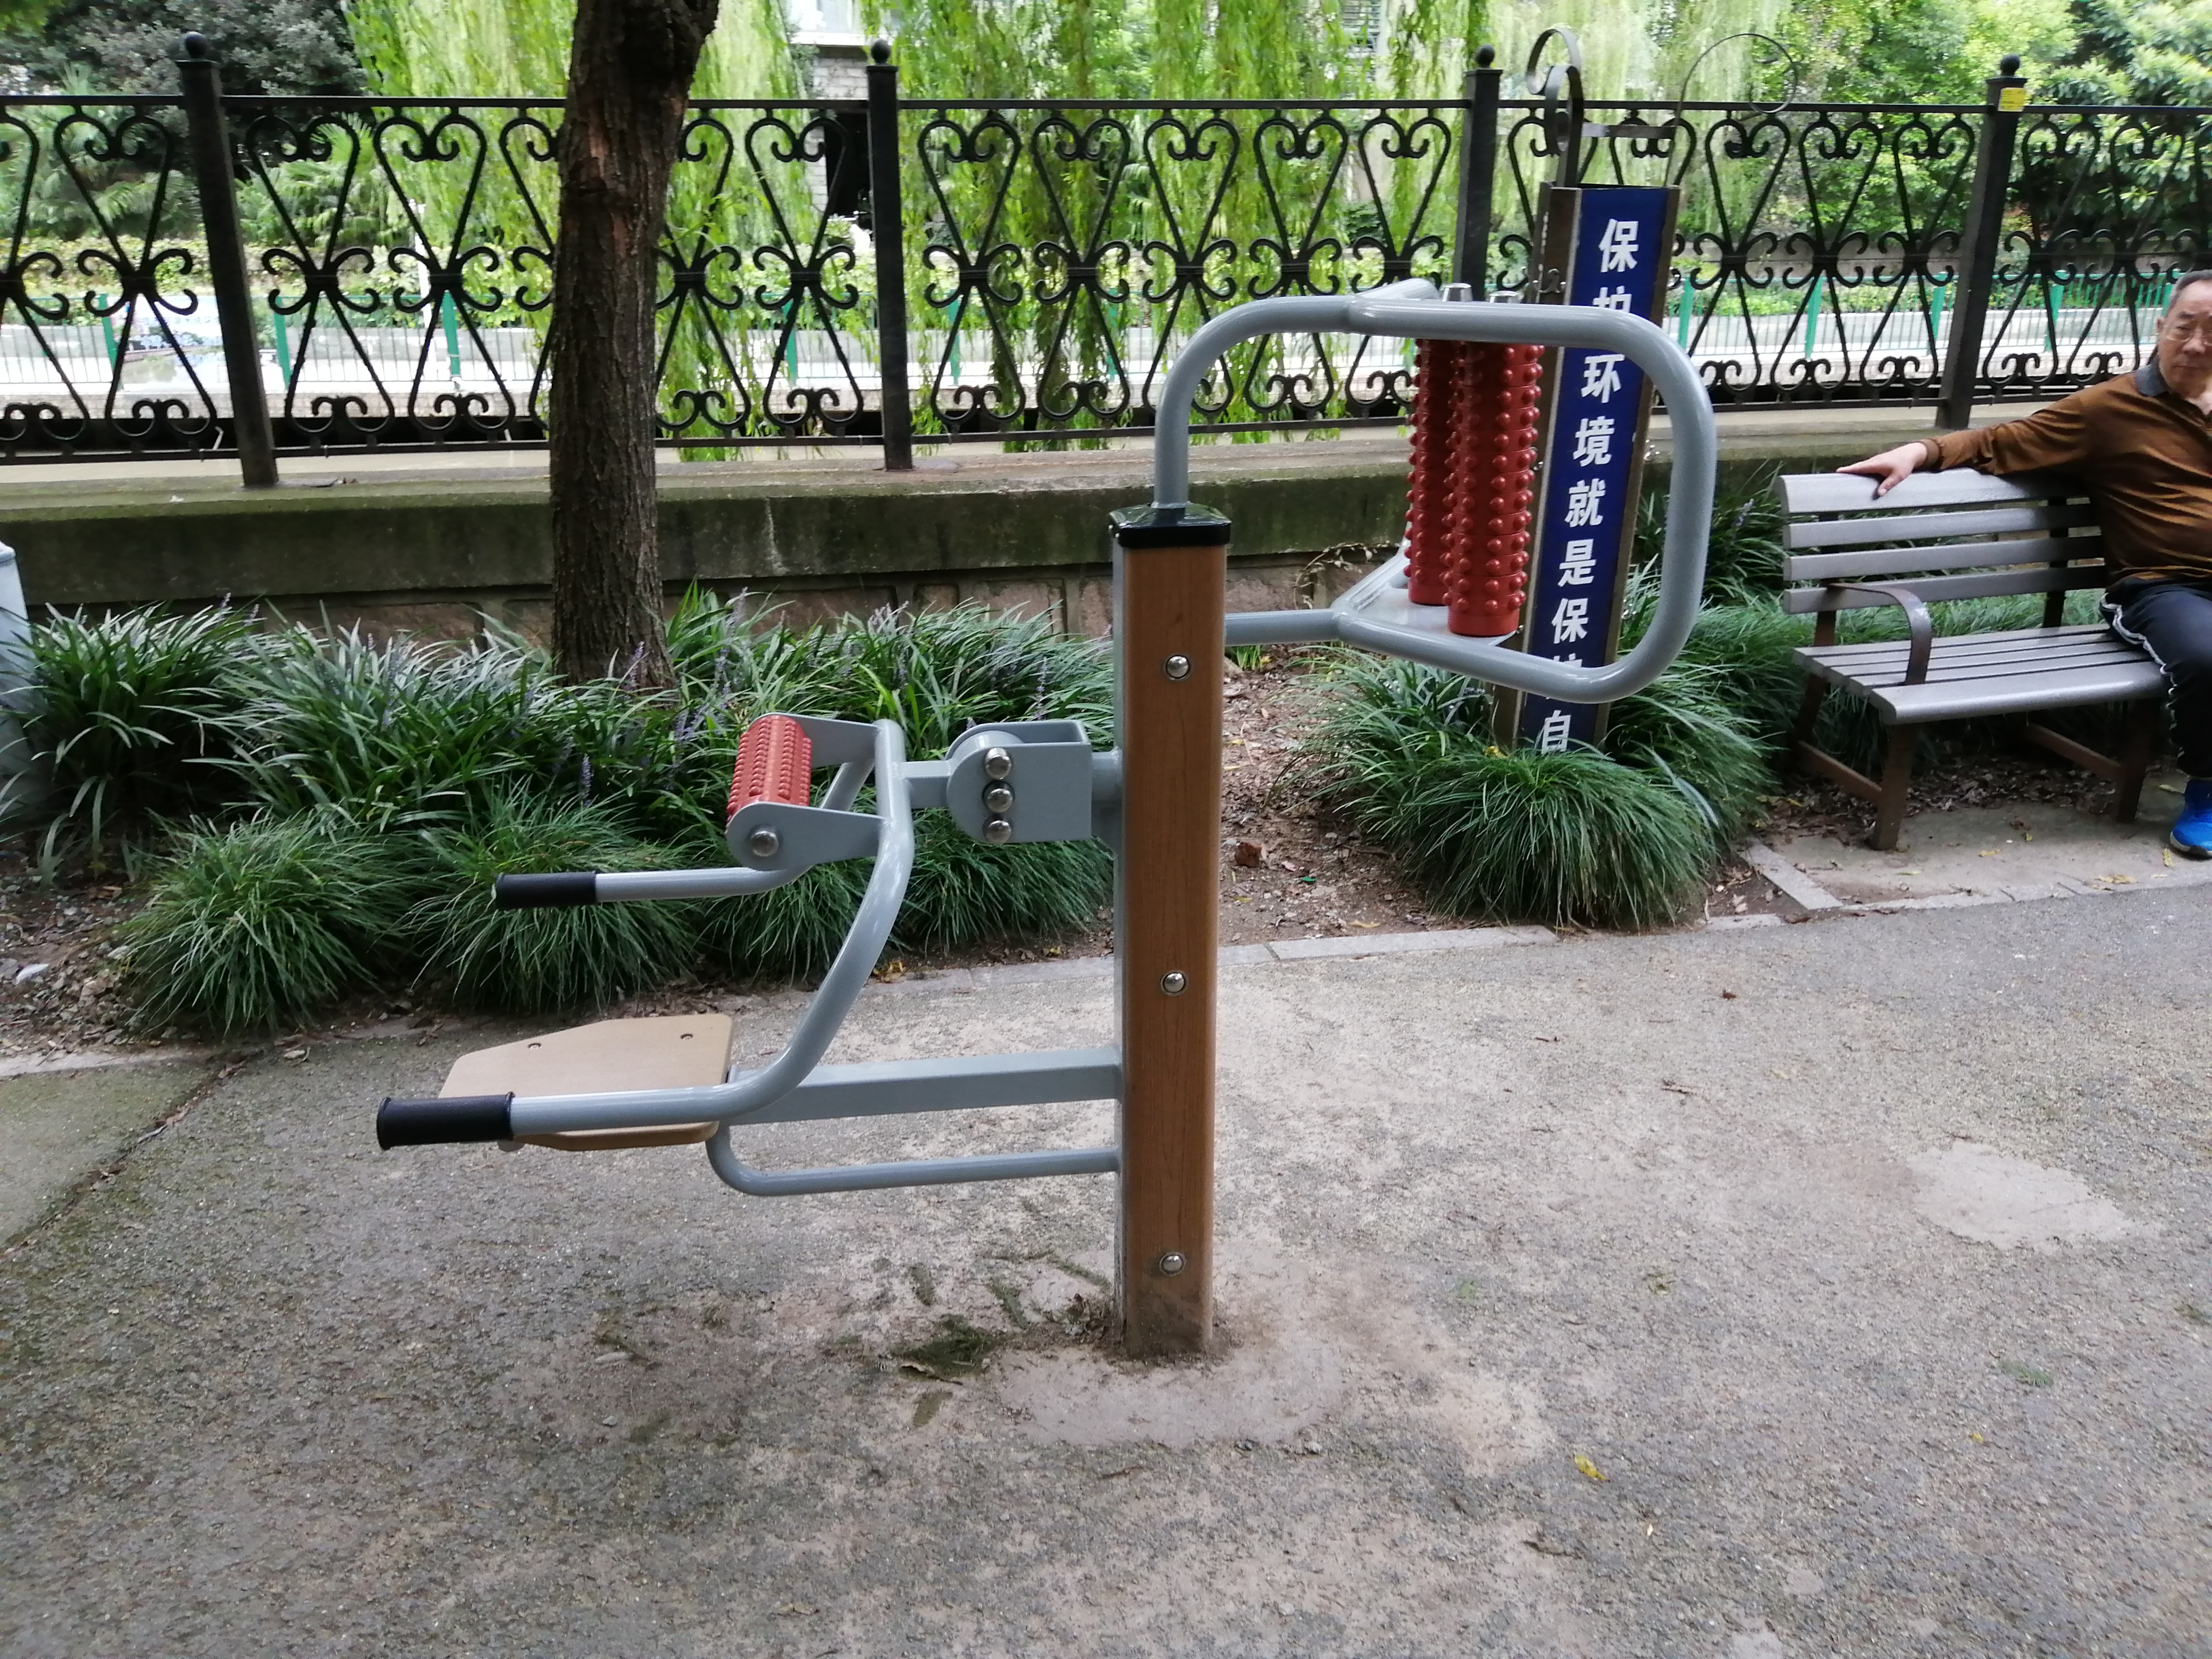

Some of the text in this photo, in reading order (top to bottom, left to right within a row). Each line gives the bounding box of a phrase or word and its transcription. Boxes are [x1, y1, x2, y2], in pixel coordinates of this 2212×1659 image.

[1541, 219, 1639, 755] 保护环境就是保自
